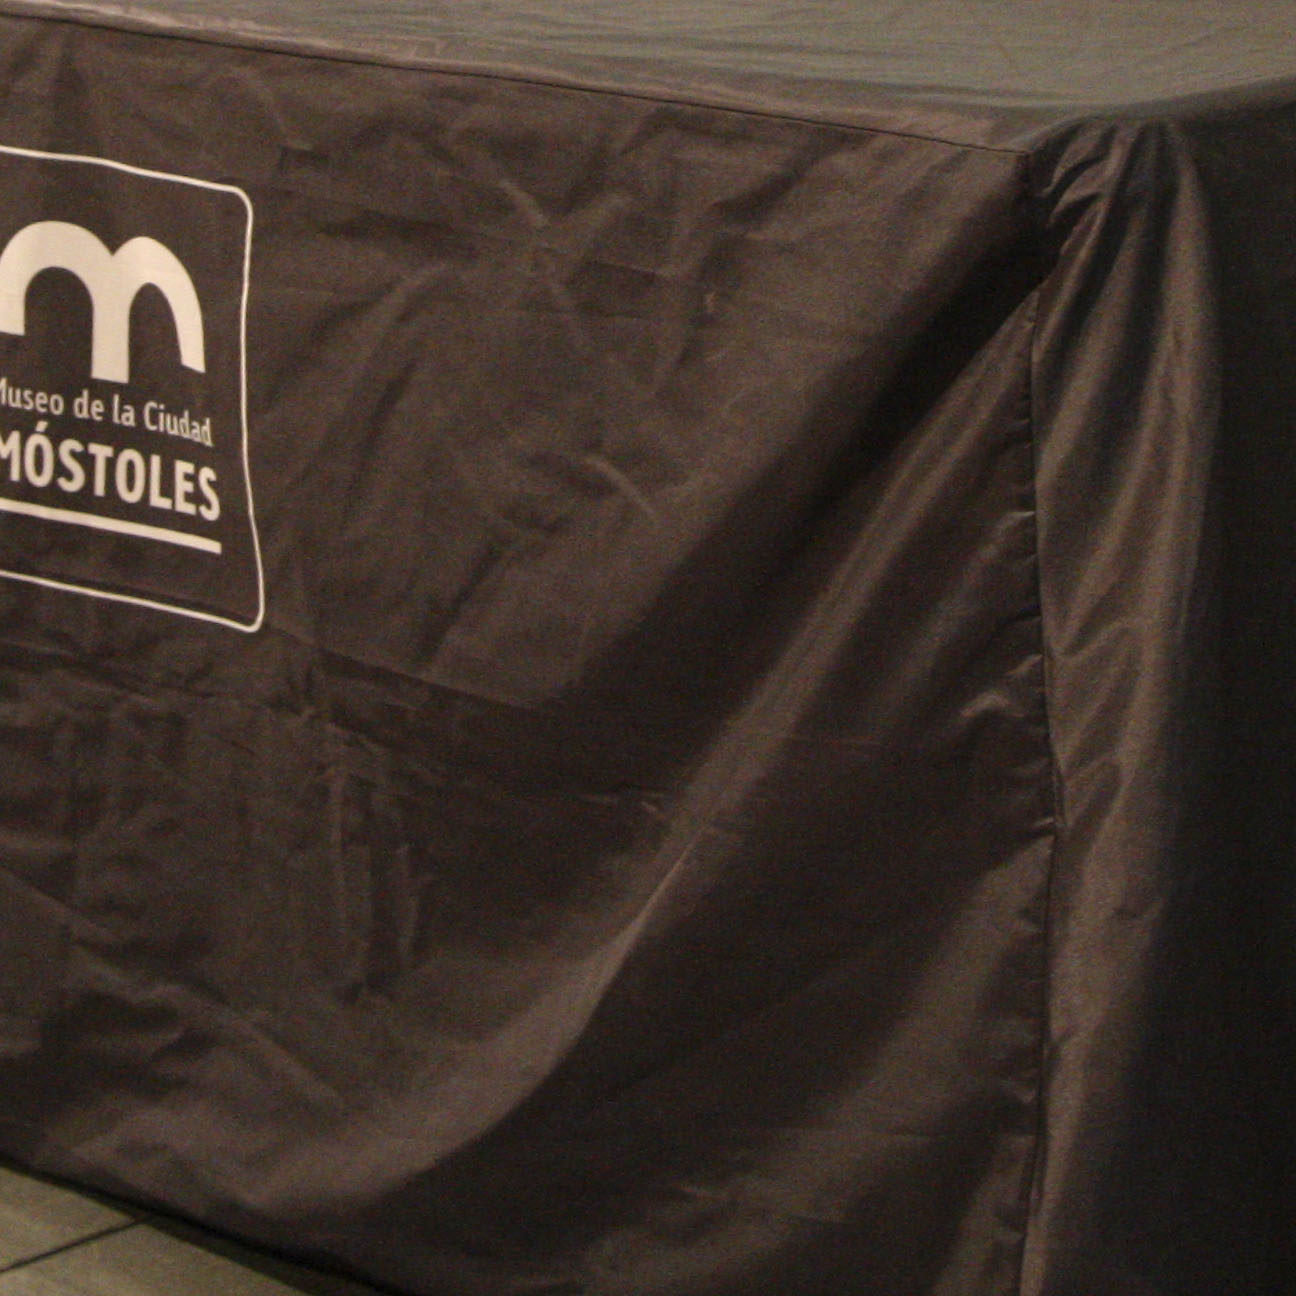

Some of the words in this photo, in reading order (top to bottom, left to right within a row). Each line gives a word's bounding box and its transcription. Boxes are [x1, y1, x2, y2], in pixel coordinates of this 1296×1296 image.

[73, 388, 104, 422] de
[113, 395, 136, 429] la
[143, 401, 213, 447] Ciudad
